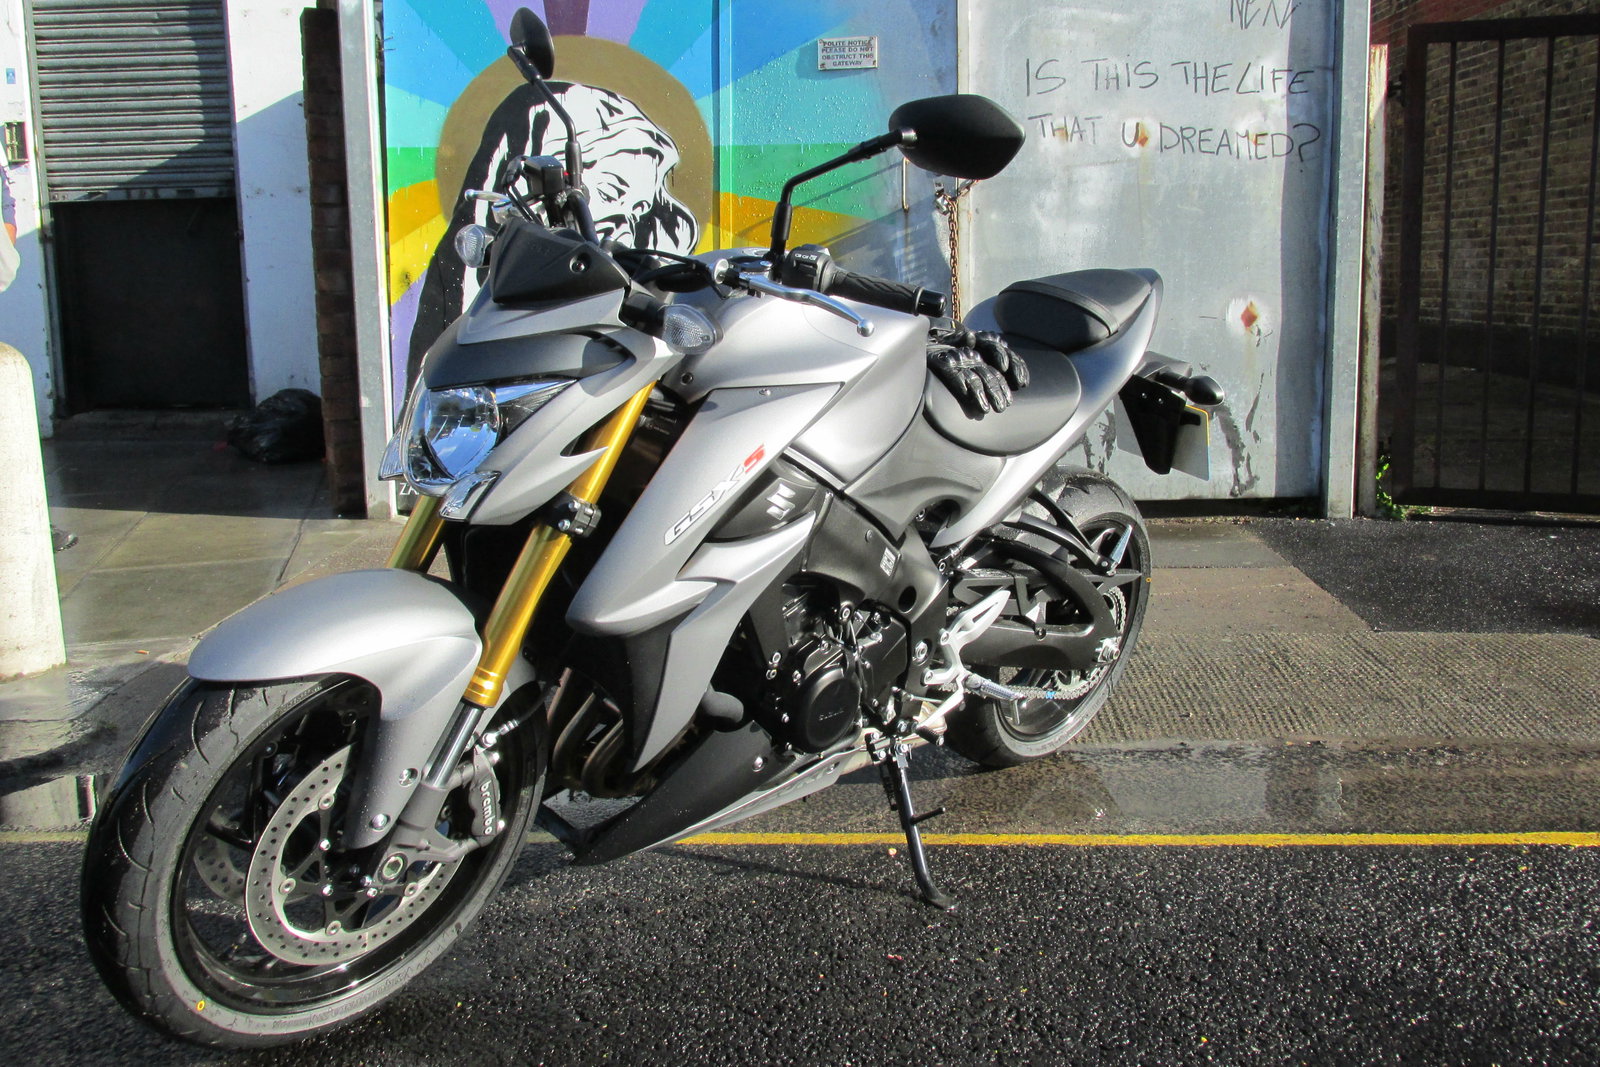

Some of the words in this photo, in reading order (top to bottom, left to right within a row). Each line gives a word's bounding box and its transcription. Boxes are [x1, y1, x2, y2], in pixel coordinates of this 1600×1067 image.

[1026, 58, 1066, 96] IS
[1081, 58, 1159, 91] THIS
[1171, 61, 1232, 96] THE
[1236, 62, 1315, 94] LIFE
[1027, 113, 1103, 145] THAT
[1121, 122, 1140, 148] U
[1159, 122, 1321, 173] DREAMED?
[481, 780, 495, 835] brembo
